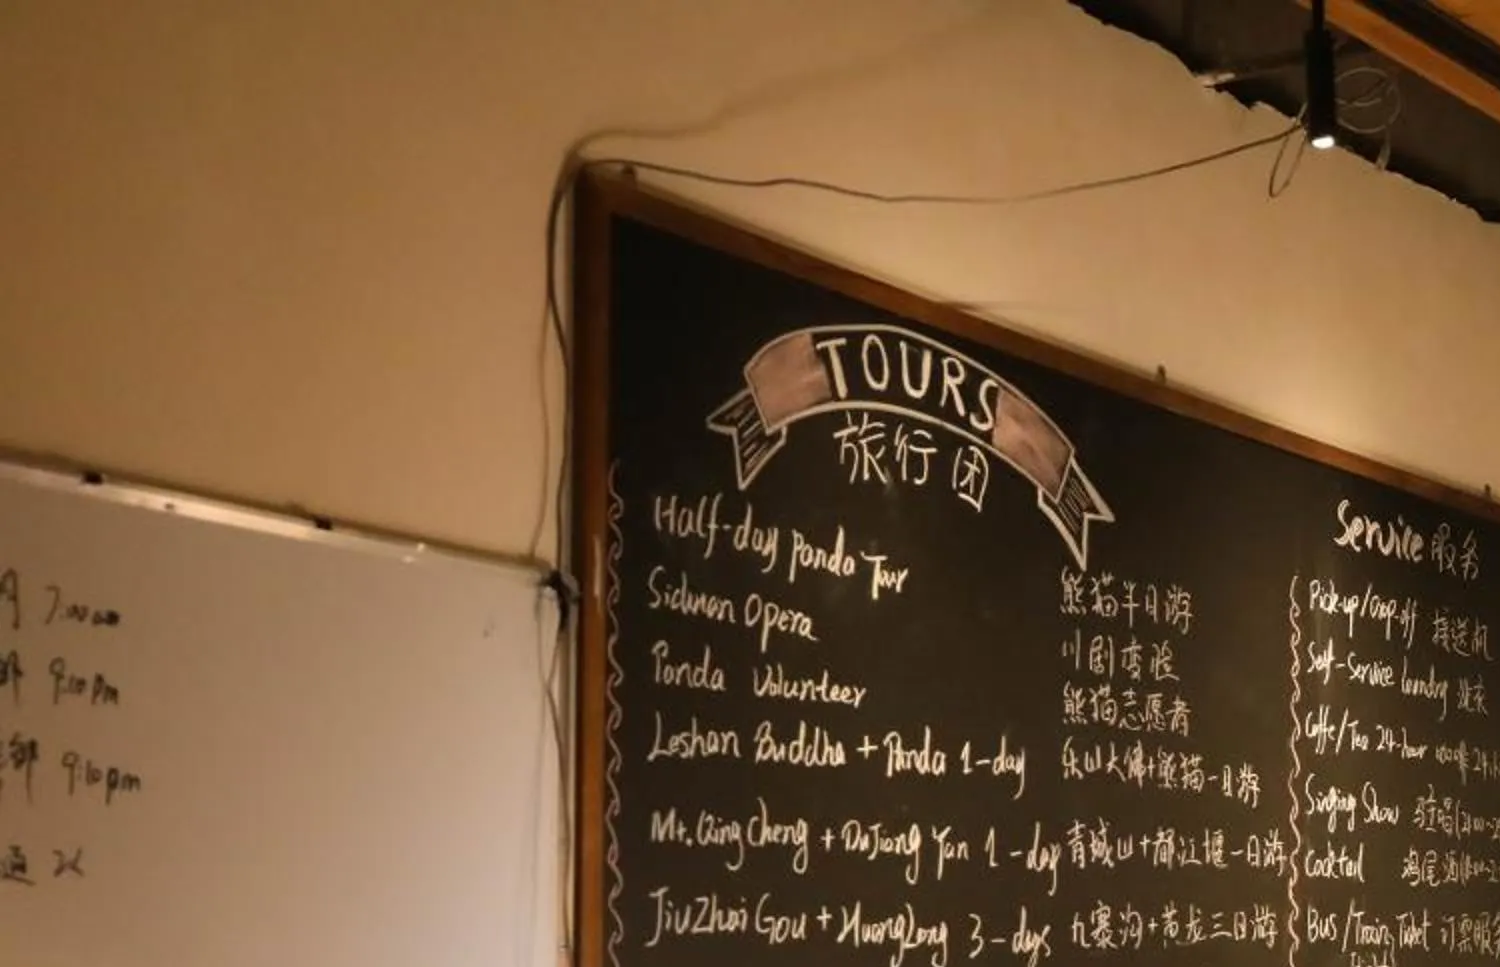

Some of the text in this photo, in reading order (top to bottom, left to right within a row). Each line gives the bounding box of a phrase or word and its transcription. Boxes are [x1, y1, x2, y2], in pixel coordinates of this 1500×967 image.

[815, 334, 1000, 432] TOURS
[834, 410, 990, 512] 旅行团
[653, 494, 780, 573] Half-day
[1333, 499, 1424, 564] Service
[744, 598, 818, 652] Opera
[1061, 566, 1194, 636] 熊猫半日游
[753, 664, 868, 709] Volunteer
[1062, 680, 1192, 738] 熊猫志愿者
[647, 711, 742, 763] Leshan
[754, 721, 847, 768] Buddha
